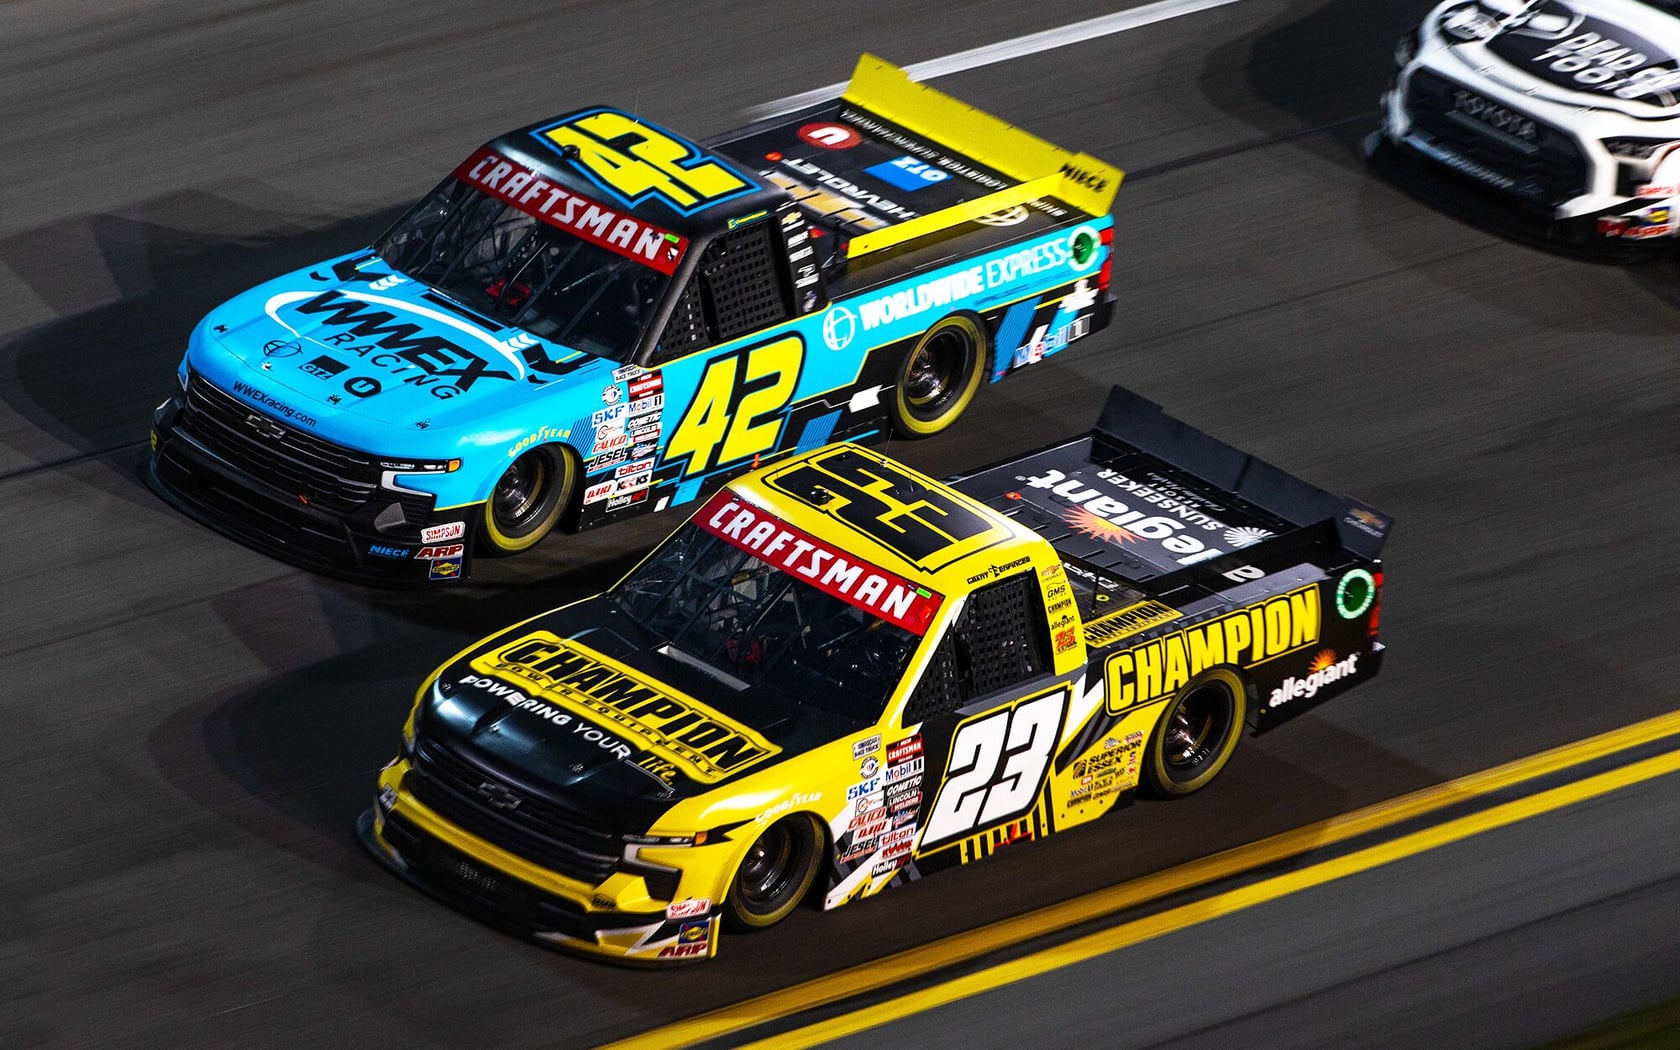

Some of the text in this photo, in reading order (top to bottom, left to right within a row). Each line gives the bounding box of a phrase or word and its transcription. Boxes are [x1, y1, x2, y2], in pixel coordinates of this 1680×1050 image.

[545, 113, 746, 207] 42
[781, 158, 918, 220] HEVROLET
[469, 156, 666, 260] CRAFTSMAN
[859, 265, 984, 331] WORLDWIDE
[986, 237, 1071, 288] EXPRESS
[296, 289, 518, 393] WWEX
[322, 332, 462, 401] RACING
[233, 381, 317, 427] WWEXracing.com
[594, 405, 625, 425] SKF
[629, 398, 652, 413] Mobil
[664, 337, 803, 475] 42
[508, 425, 571, 457] GOODYEAR
[592, 435, 626, 453] CALICO
[589, 448, 626, 467] JESEL
[618, 462, 651, 475] tilton
[774, 451, 993, 562] 23
[1097, 468, 1225, 531] SUNSEEKER
[1148, 482, 1201, 508] RESORT
[426, 525, 460, 541] SIMPSON
[418, 545, 463, 559] ARP
[709, 502, 917, 620] CRAFTSMAN
[1047, 585, 1065, 598] GMS
[1108, 589, 1318, 713] CHAMPION
[1269, 652, 1358, 708] allegiant
[458, 674, 631, 760] POWERING YOUR
[503, 640, 763, 771] CHAMPION
[888, 742, 922, 760] CRAFTSMAN
[885, 763, 911, 781] Mobil
[913, 758, 922, 771] 1
[921, 691, 1066, 847] 23
[848, 778, 881, 800] SKF
[887, 776, 921, 796] COMETIC
[890, 789, 917, 805] LINCOLN
[848, 807, 886, 829] CALICO
[881, 827, 913, 844] tilton
[841, 838, 877, 858] JESEL
[873, 858, 898, 875] Holley
[657, 943, 708, 957] ARP
